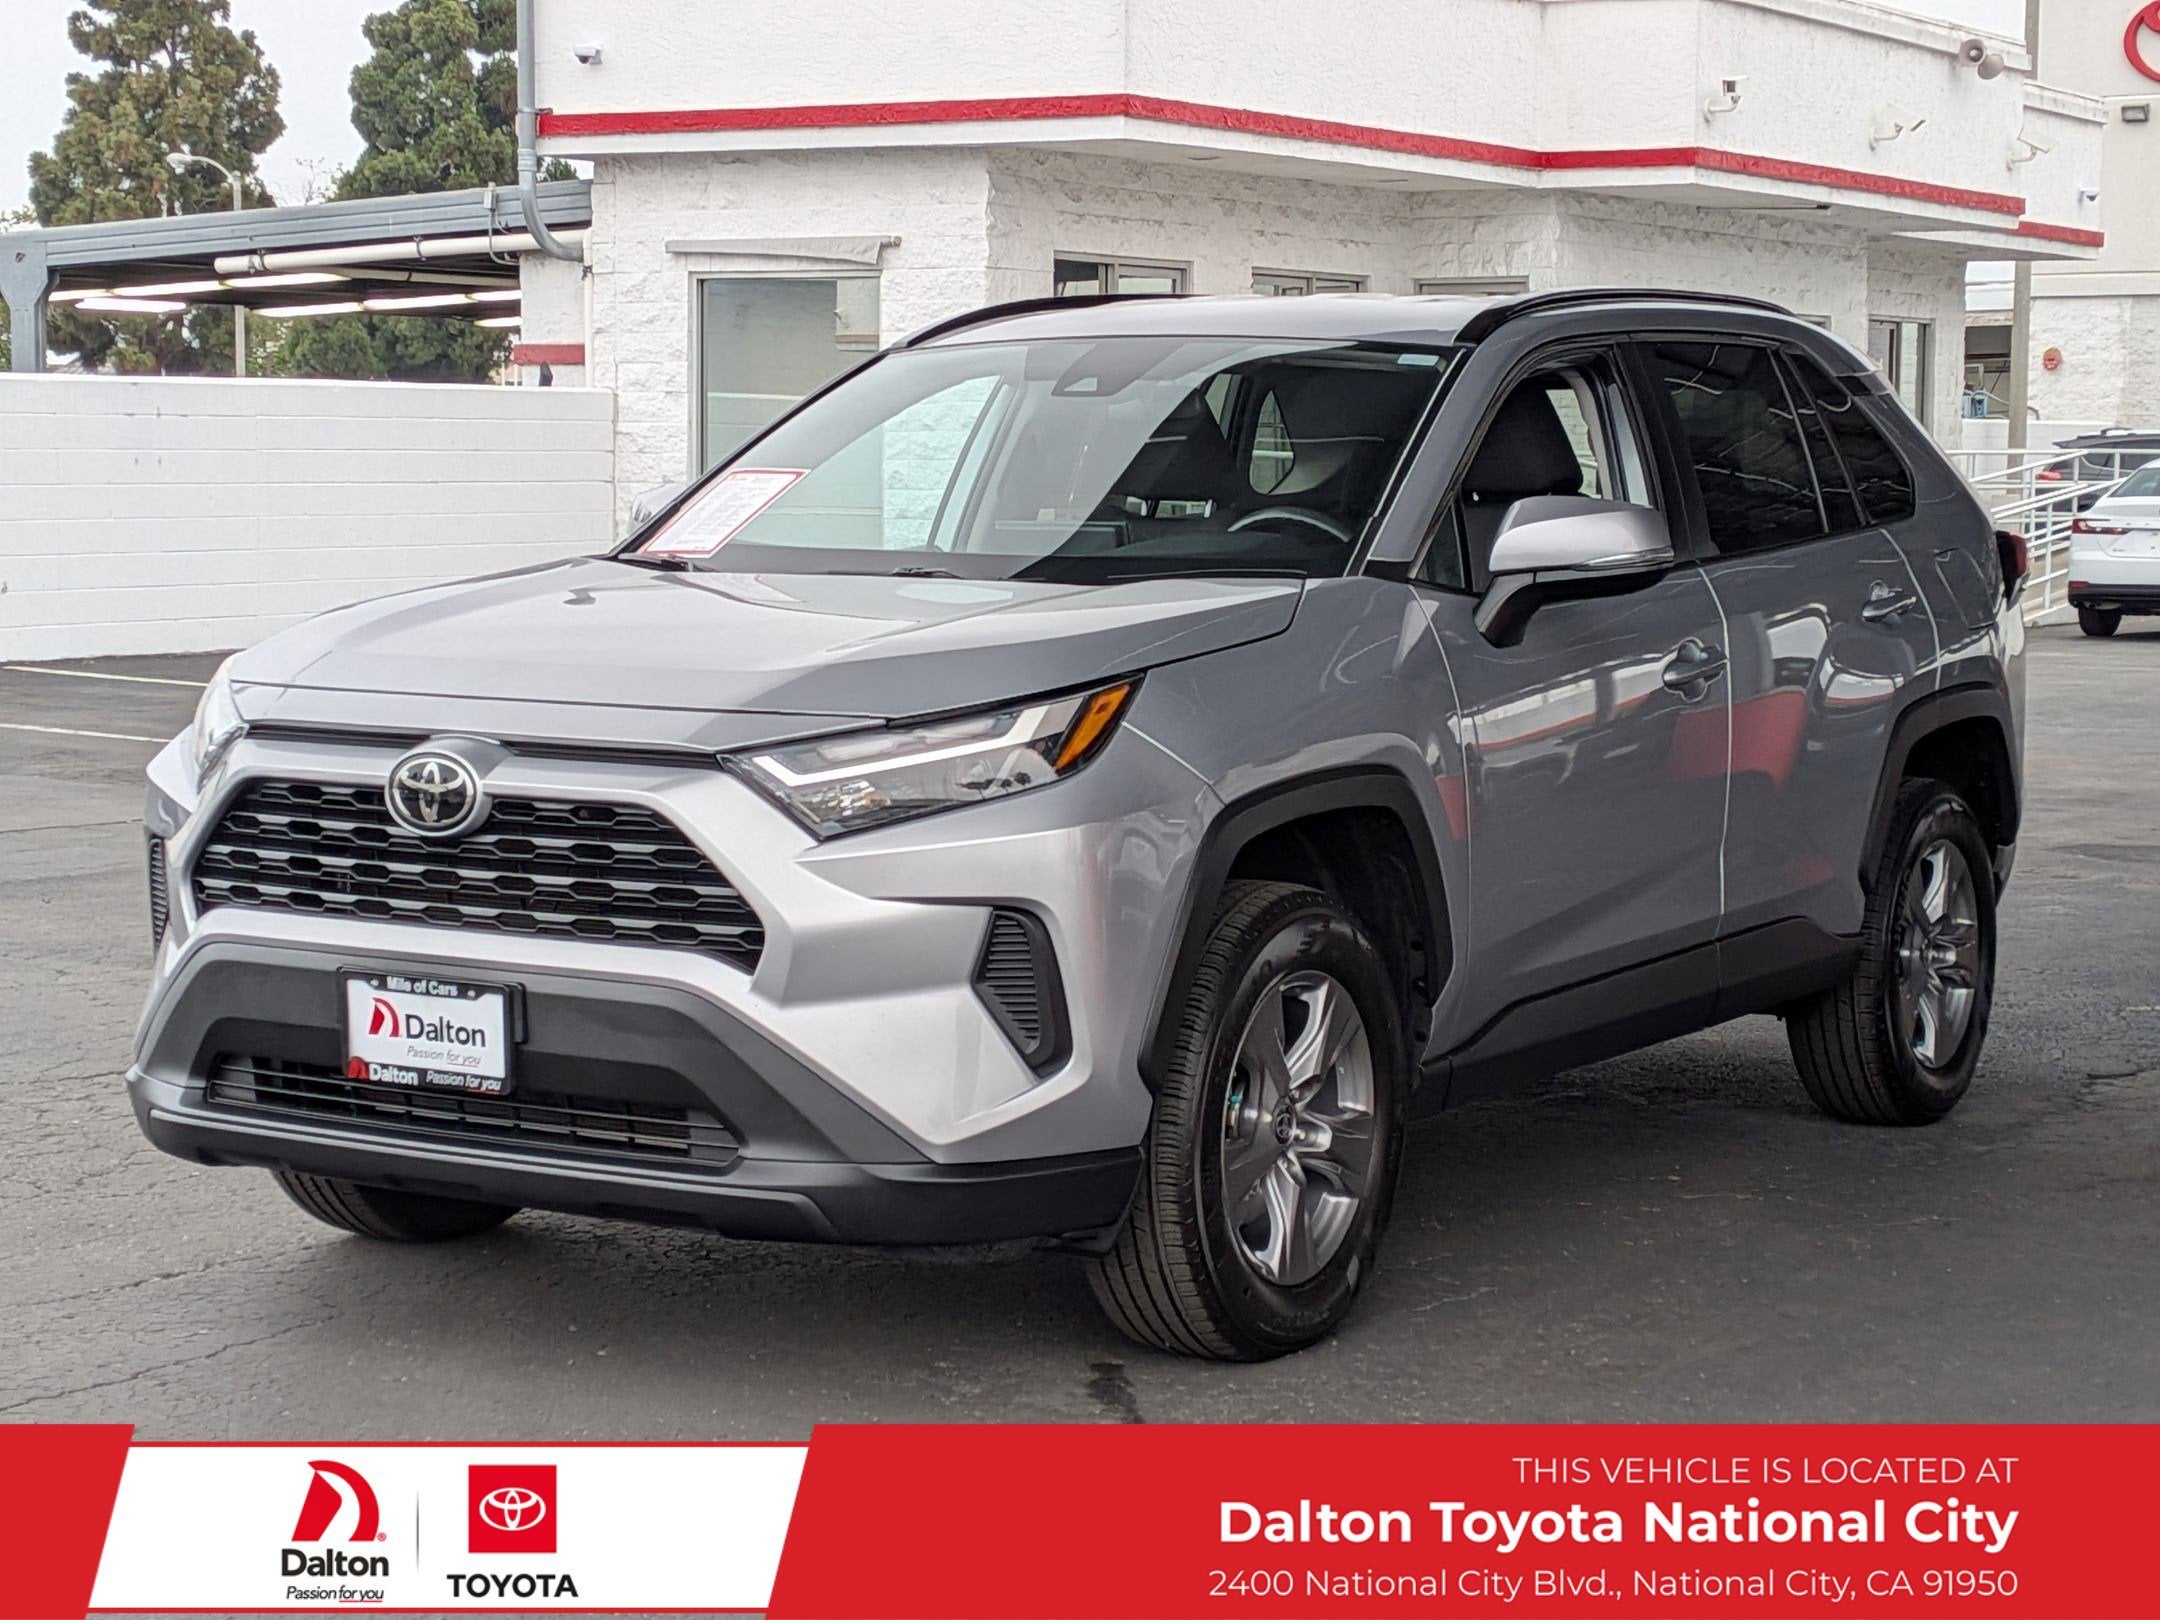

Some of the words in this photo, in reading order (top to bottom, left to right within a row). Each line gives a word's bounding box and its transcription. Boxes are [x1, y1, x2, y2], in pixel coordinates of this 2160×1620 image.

[386, 975, 412, 992] Mile
[413, 980, 427, 993] of
[428, 981, 458, 997] Cars
[405, 1014, 486, 1047] Dalton
[406, 1045, 444, 1060] Passion
[446, 1049, 461, 1062] for
[461, 1055, 481, 1065] you
[369, 1064, 419, 1086] Dalton
[426, 1070, 465, 1087] Passion
[465, 1075, 481, 1088] for
[480, 1079, 502, 1092] you
